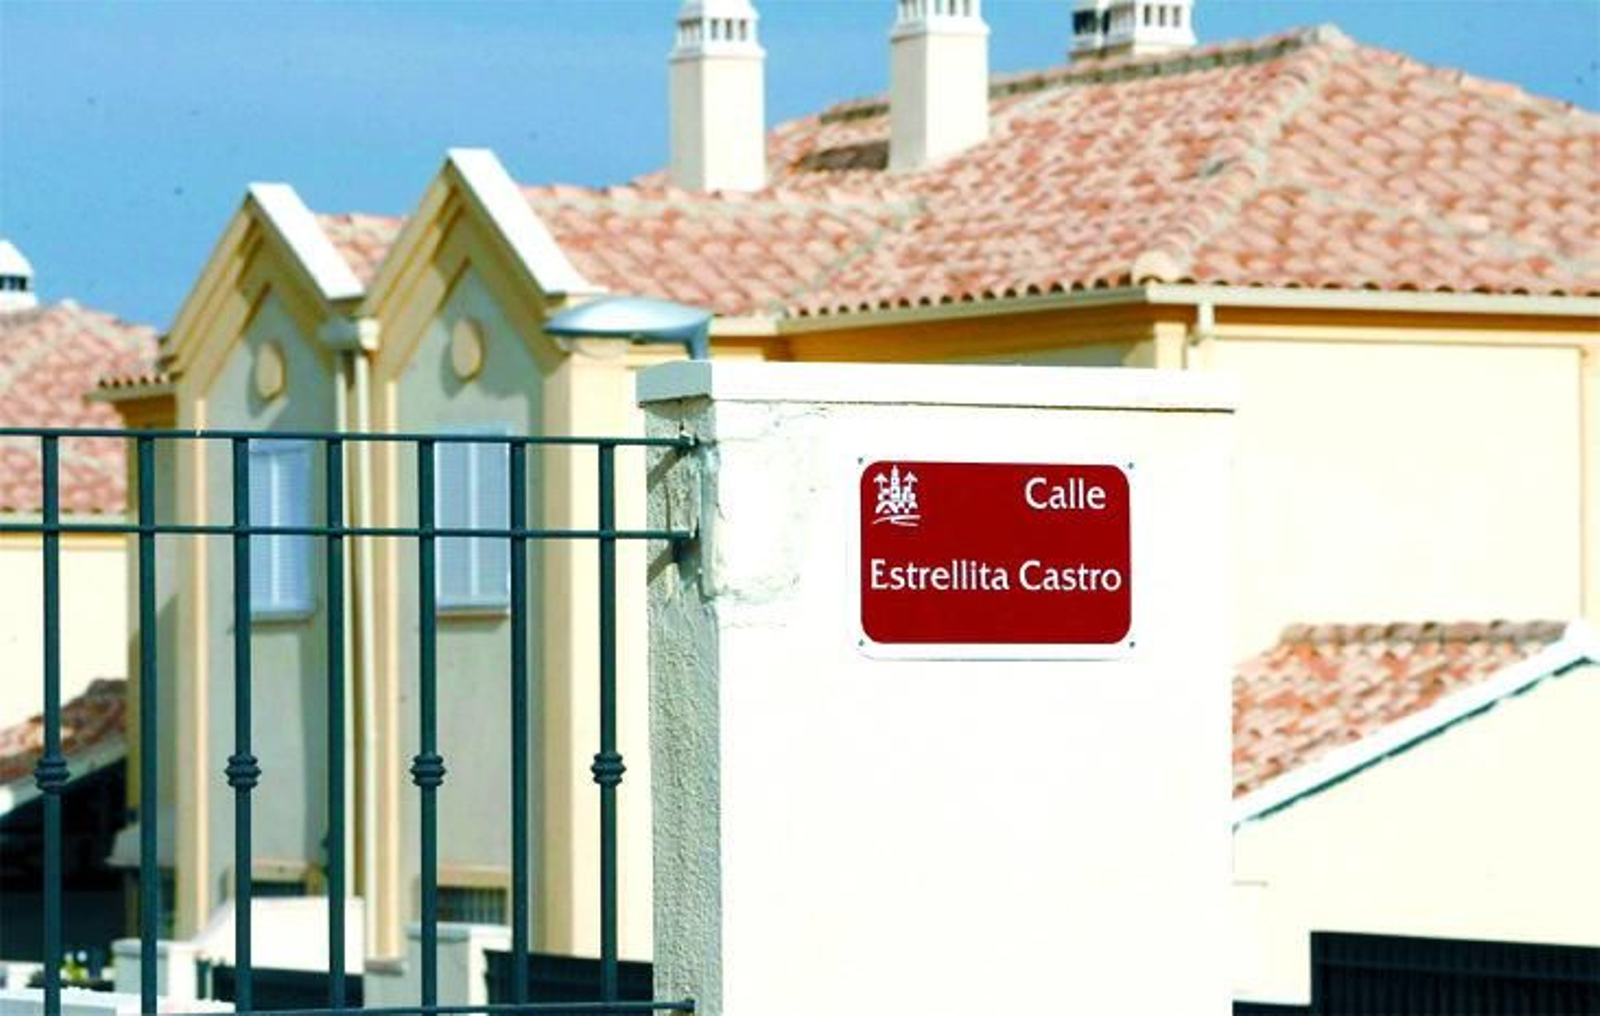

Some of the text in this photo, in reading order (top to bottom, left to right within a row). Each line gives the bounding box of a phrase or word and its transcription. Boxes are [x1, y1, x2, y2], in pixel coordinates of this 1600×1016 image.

[1024, 477, 1106, 510] Calle
[870, 558, 1122, 592] Estrellita Castro
